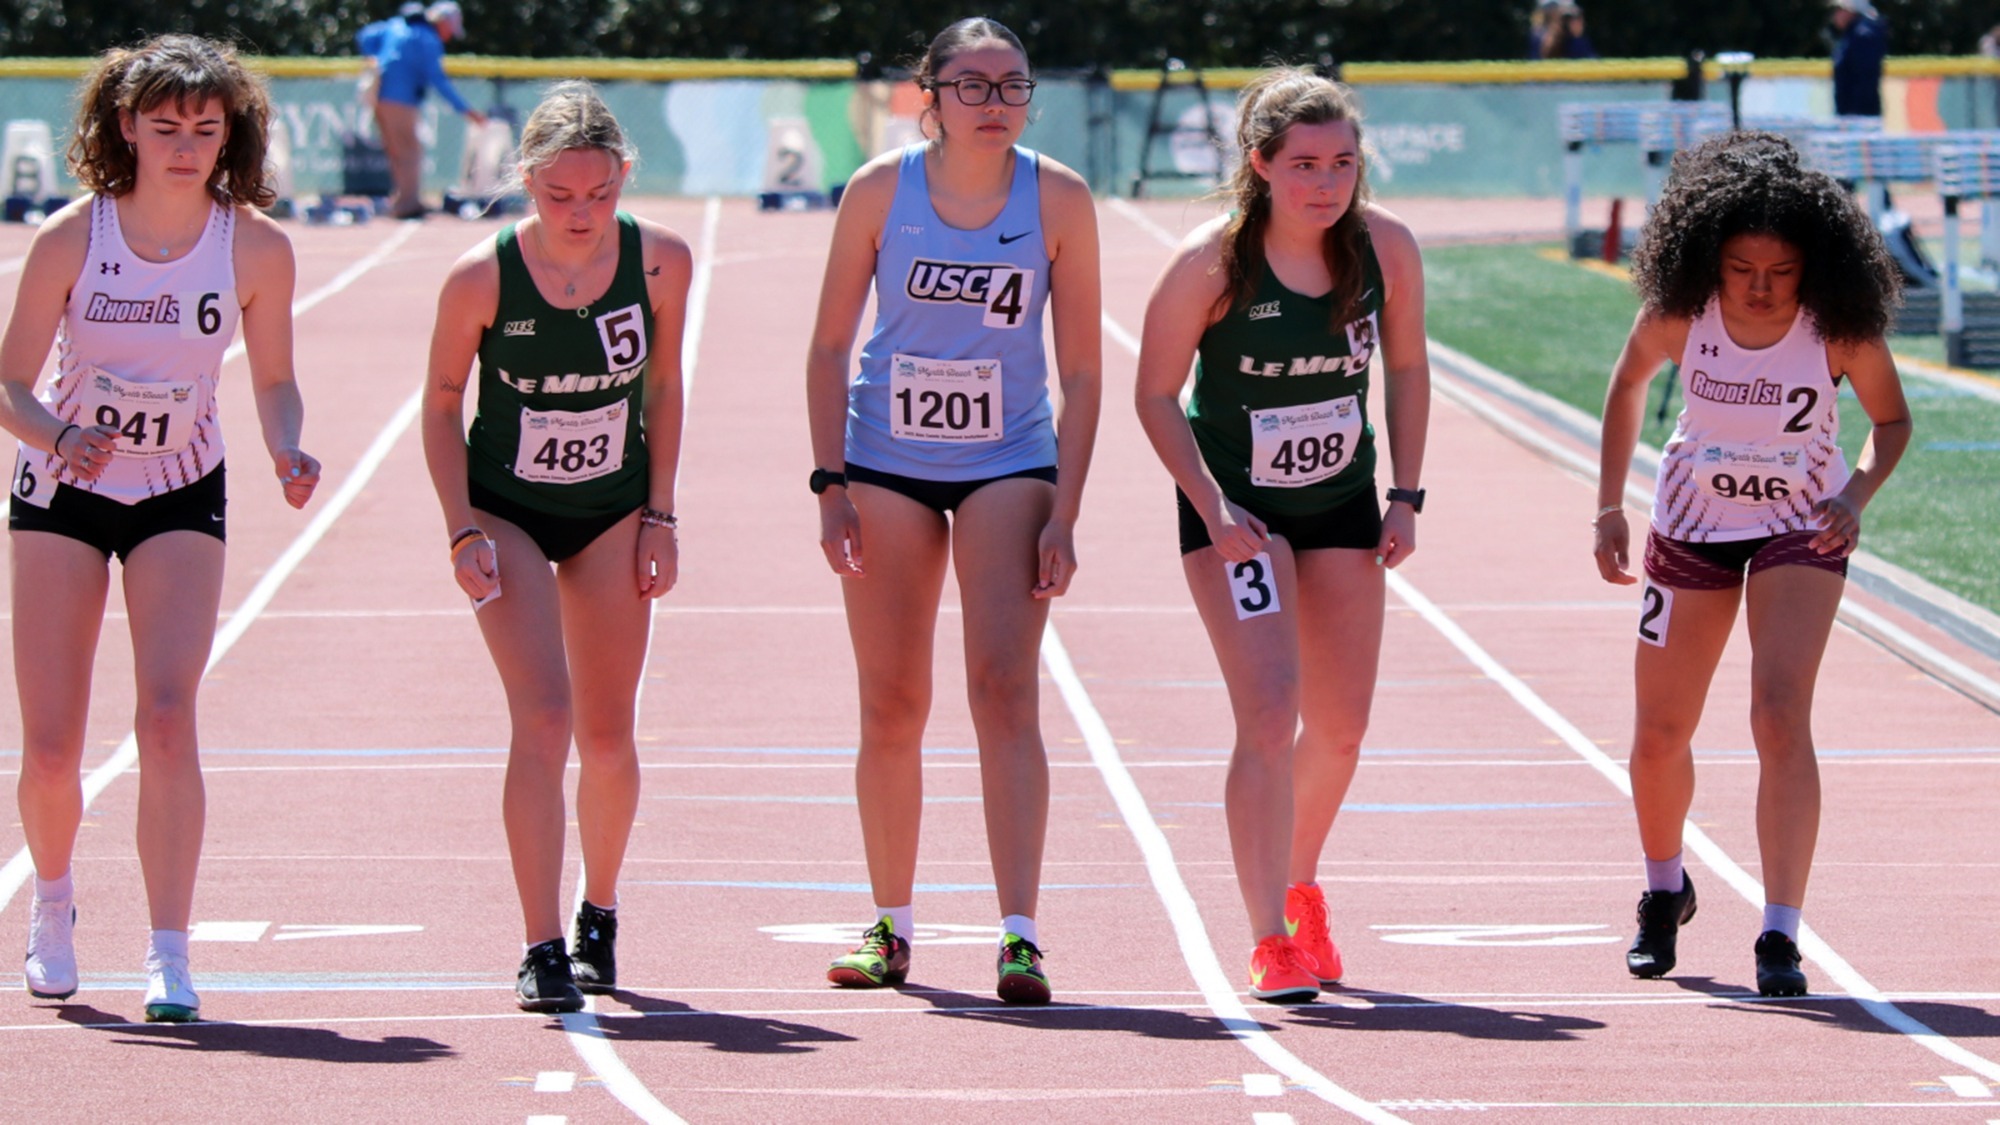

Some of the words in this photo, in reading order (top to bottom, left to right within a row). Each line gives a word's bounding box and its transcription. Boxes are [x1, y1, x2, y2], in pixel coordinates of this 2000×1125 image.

[777, 146, 805, 186] 2
[85, 291, 155, 323] RHODE
[198, 292, 222, 335] 6
[990, 273, 1024, 325] 4
[1249, 300, 1281, 318] NEC
[503, 319, 536, 335] NEC
[604, 312, 640, 366] 5
[498, 368, 538, 394] LE
[1238, 355, 1285, 378] LE
[1690, 369, 1750, 405] RHODE
[95, 404, 171, 447] 941
[896, 387, 991, 430] 1201
[1783, 386, 1819, 434] 2
[533, 433, 610, 473] 483
[1270, 432, 1345, 476] 498
[19, 460, 37, 498] 6
[1711, 473, 1791, 502] 946
[1233, 558, 1272, 613] 3
[1638, 585, 1664, 642] 2
